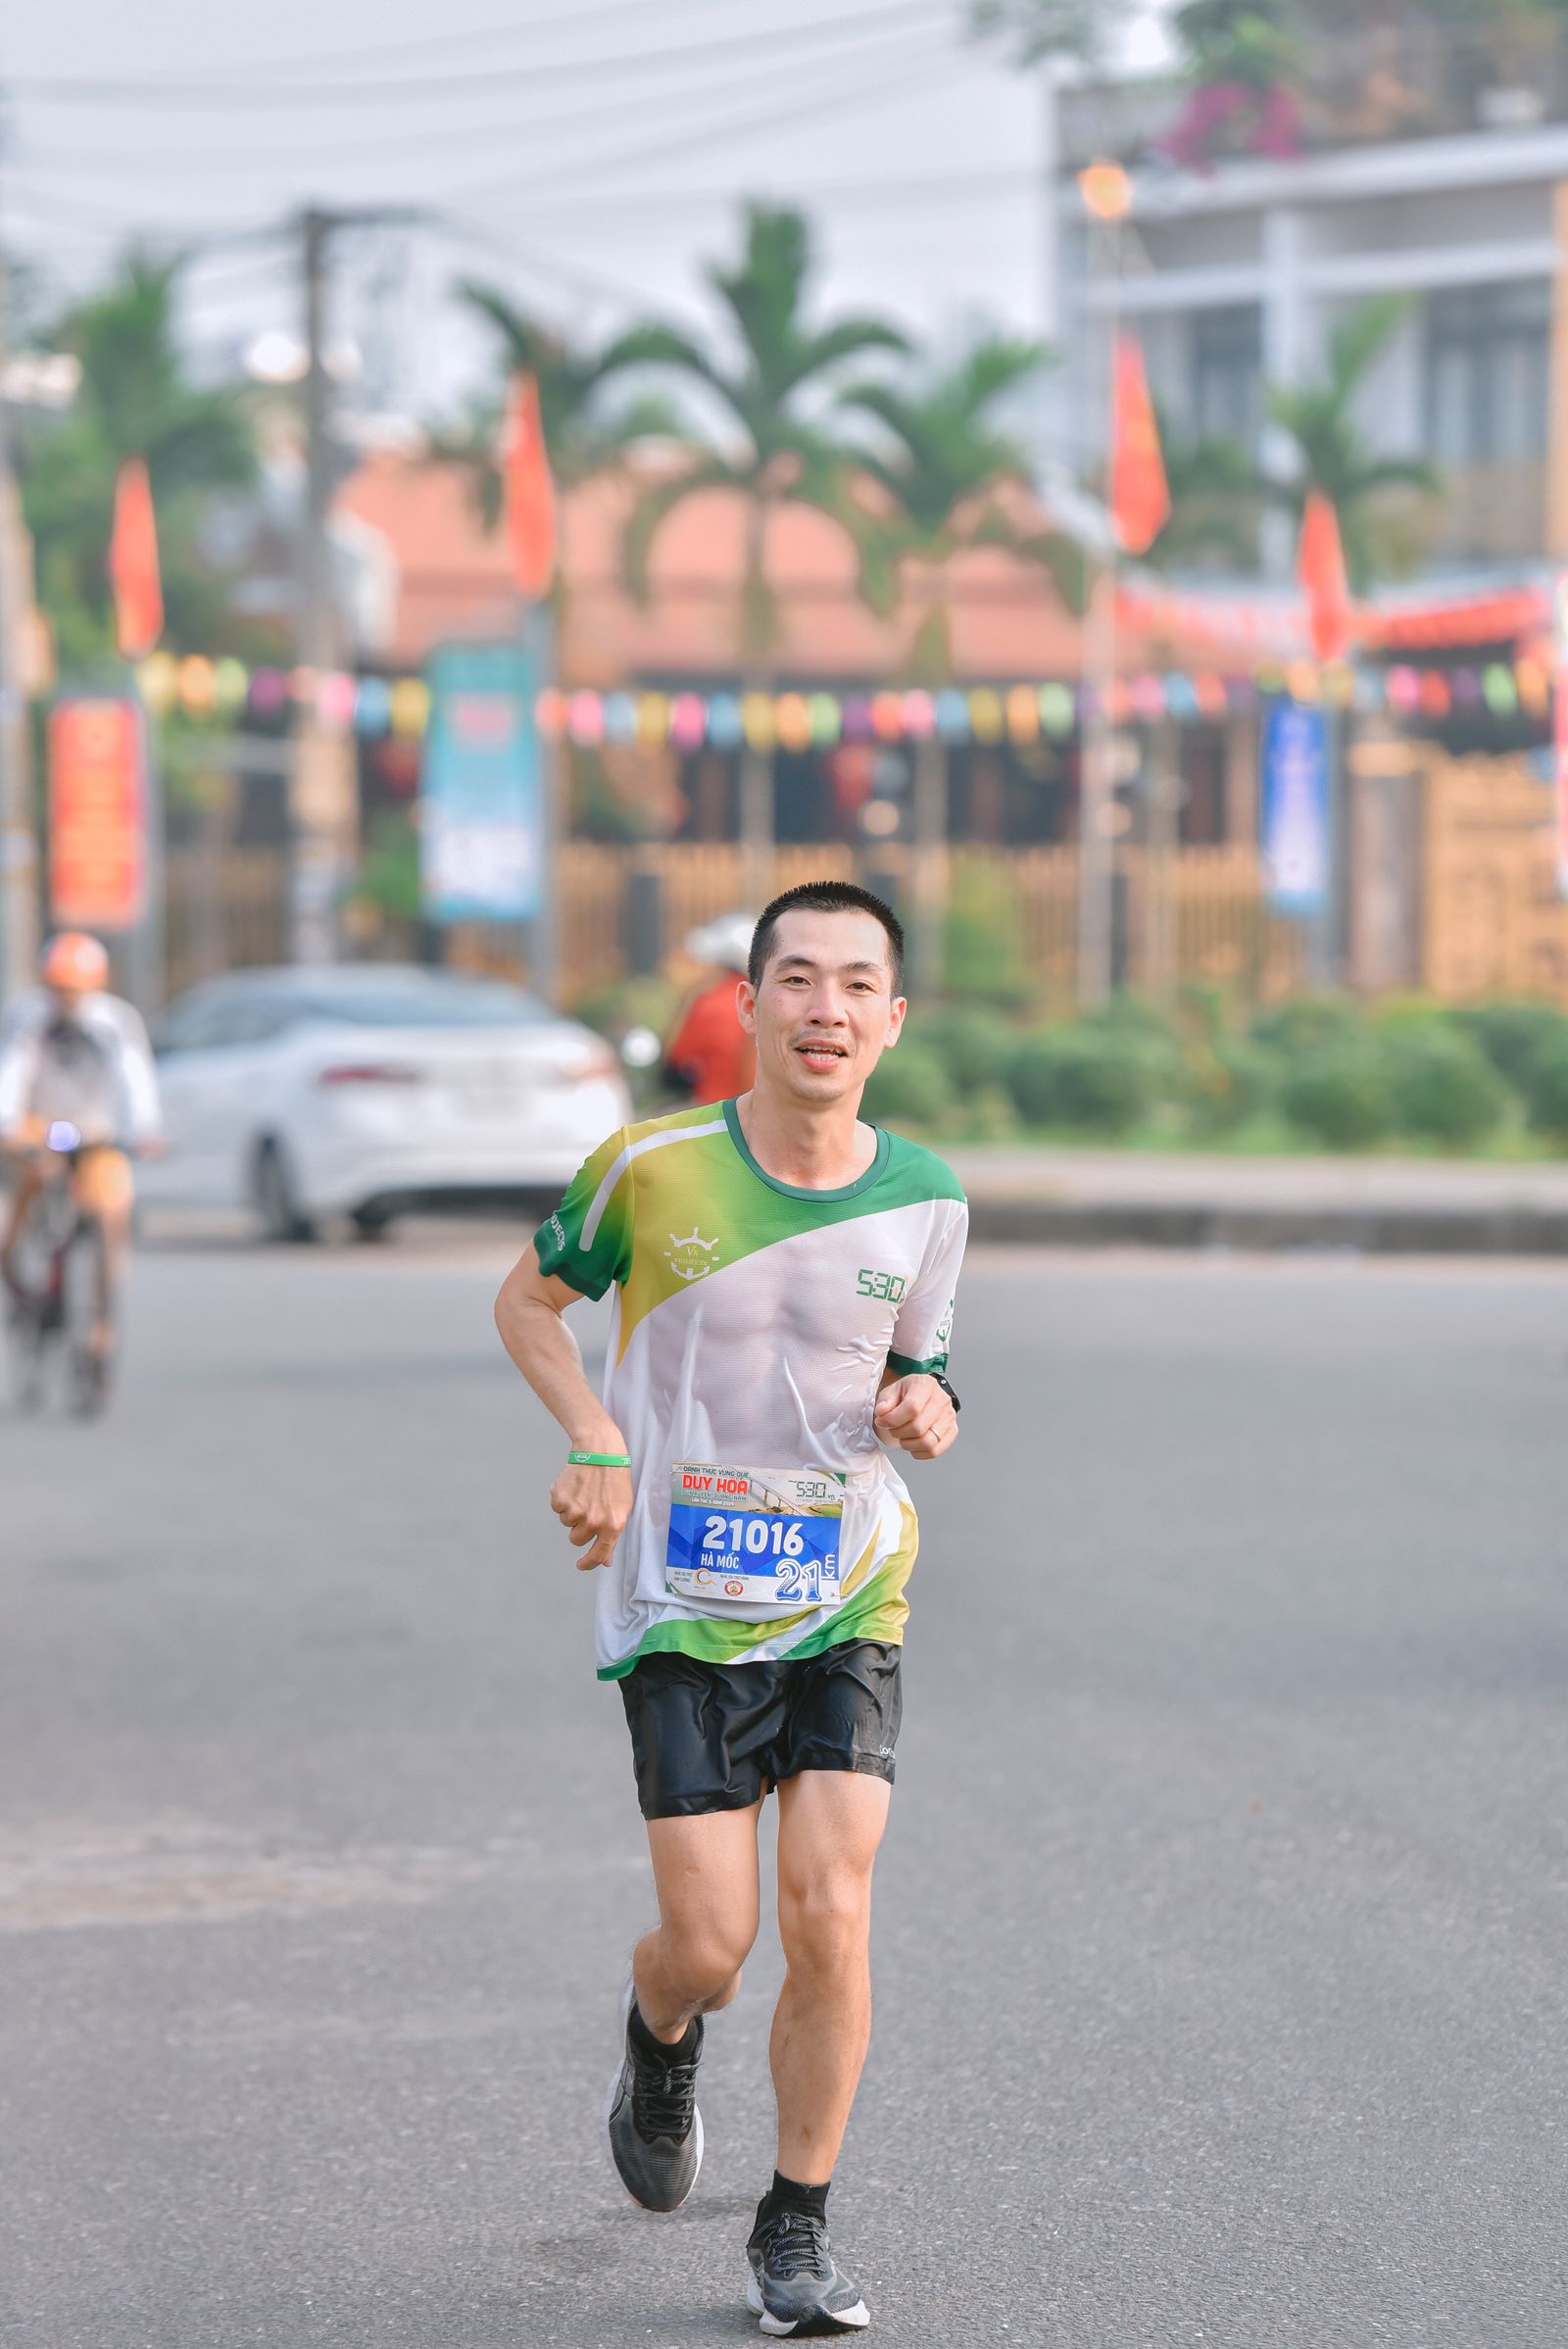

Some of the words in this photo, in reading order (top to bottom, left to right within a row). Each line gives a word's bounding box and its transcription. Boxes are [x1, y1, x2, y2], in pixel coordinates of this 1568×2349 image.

[682, 1474, 712, 1490] DUY
[703, 1516, 804, 1556] 21016
[700, 1550, 714, 1567] HÀ
[716, 1551, 740, 1570] MỐC
[821, 1553, 836, 1580] km
[775, 1558, 822, 1602] 21
